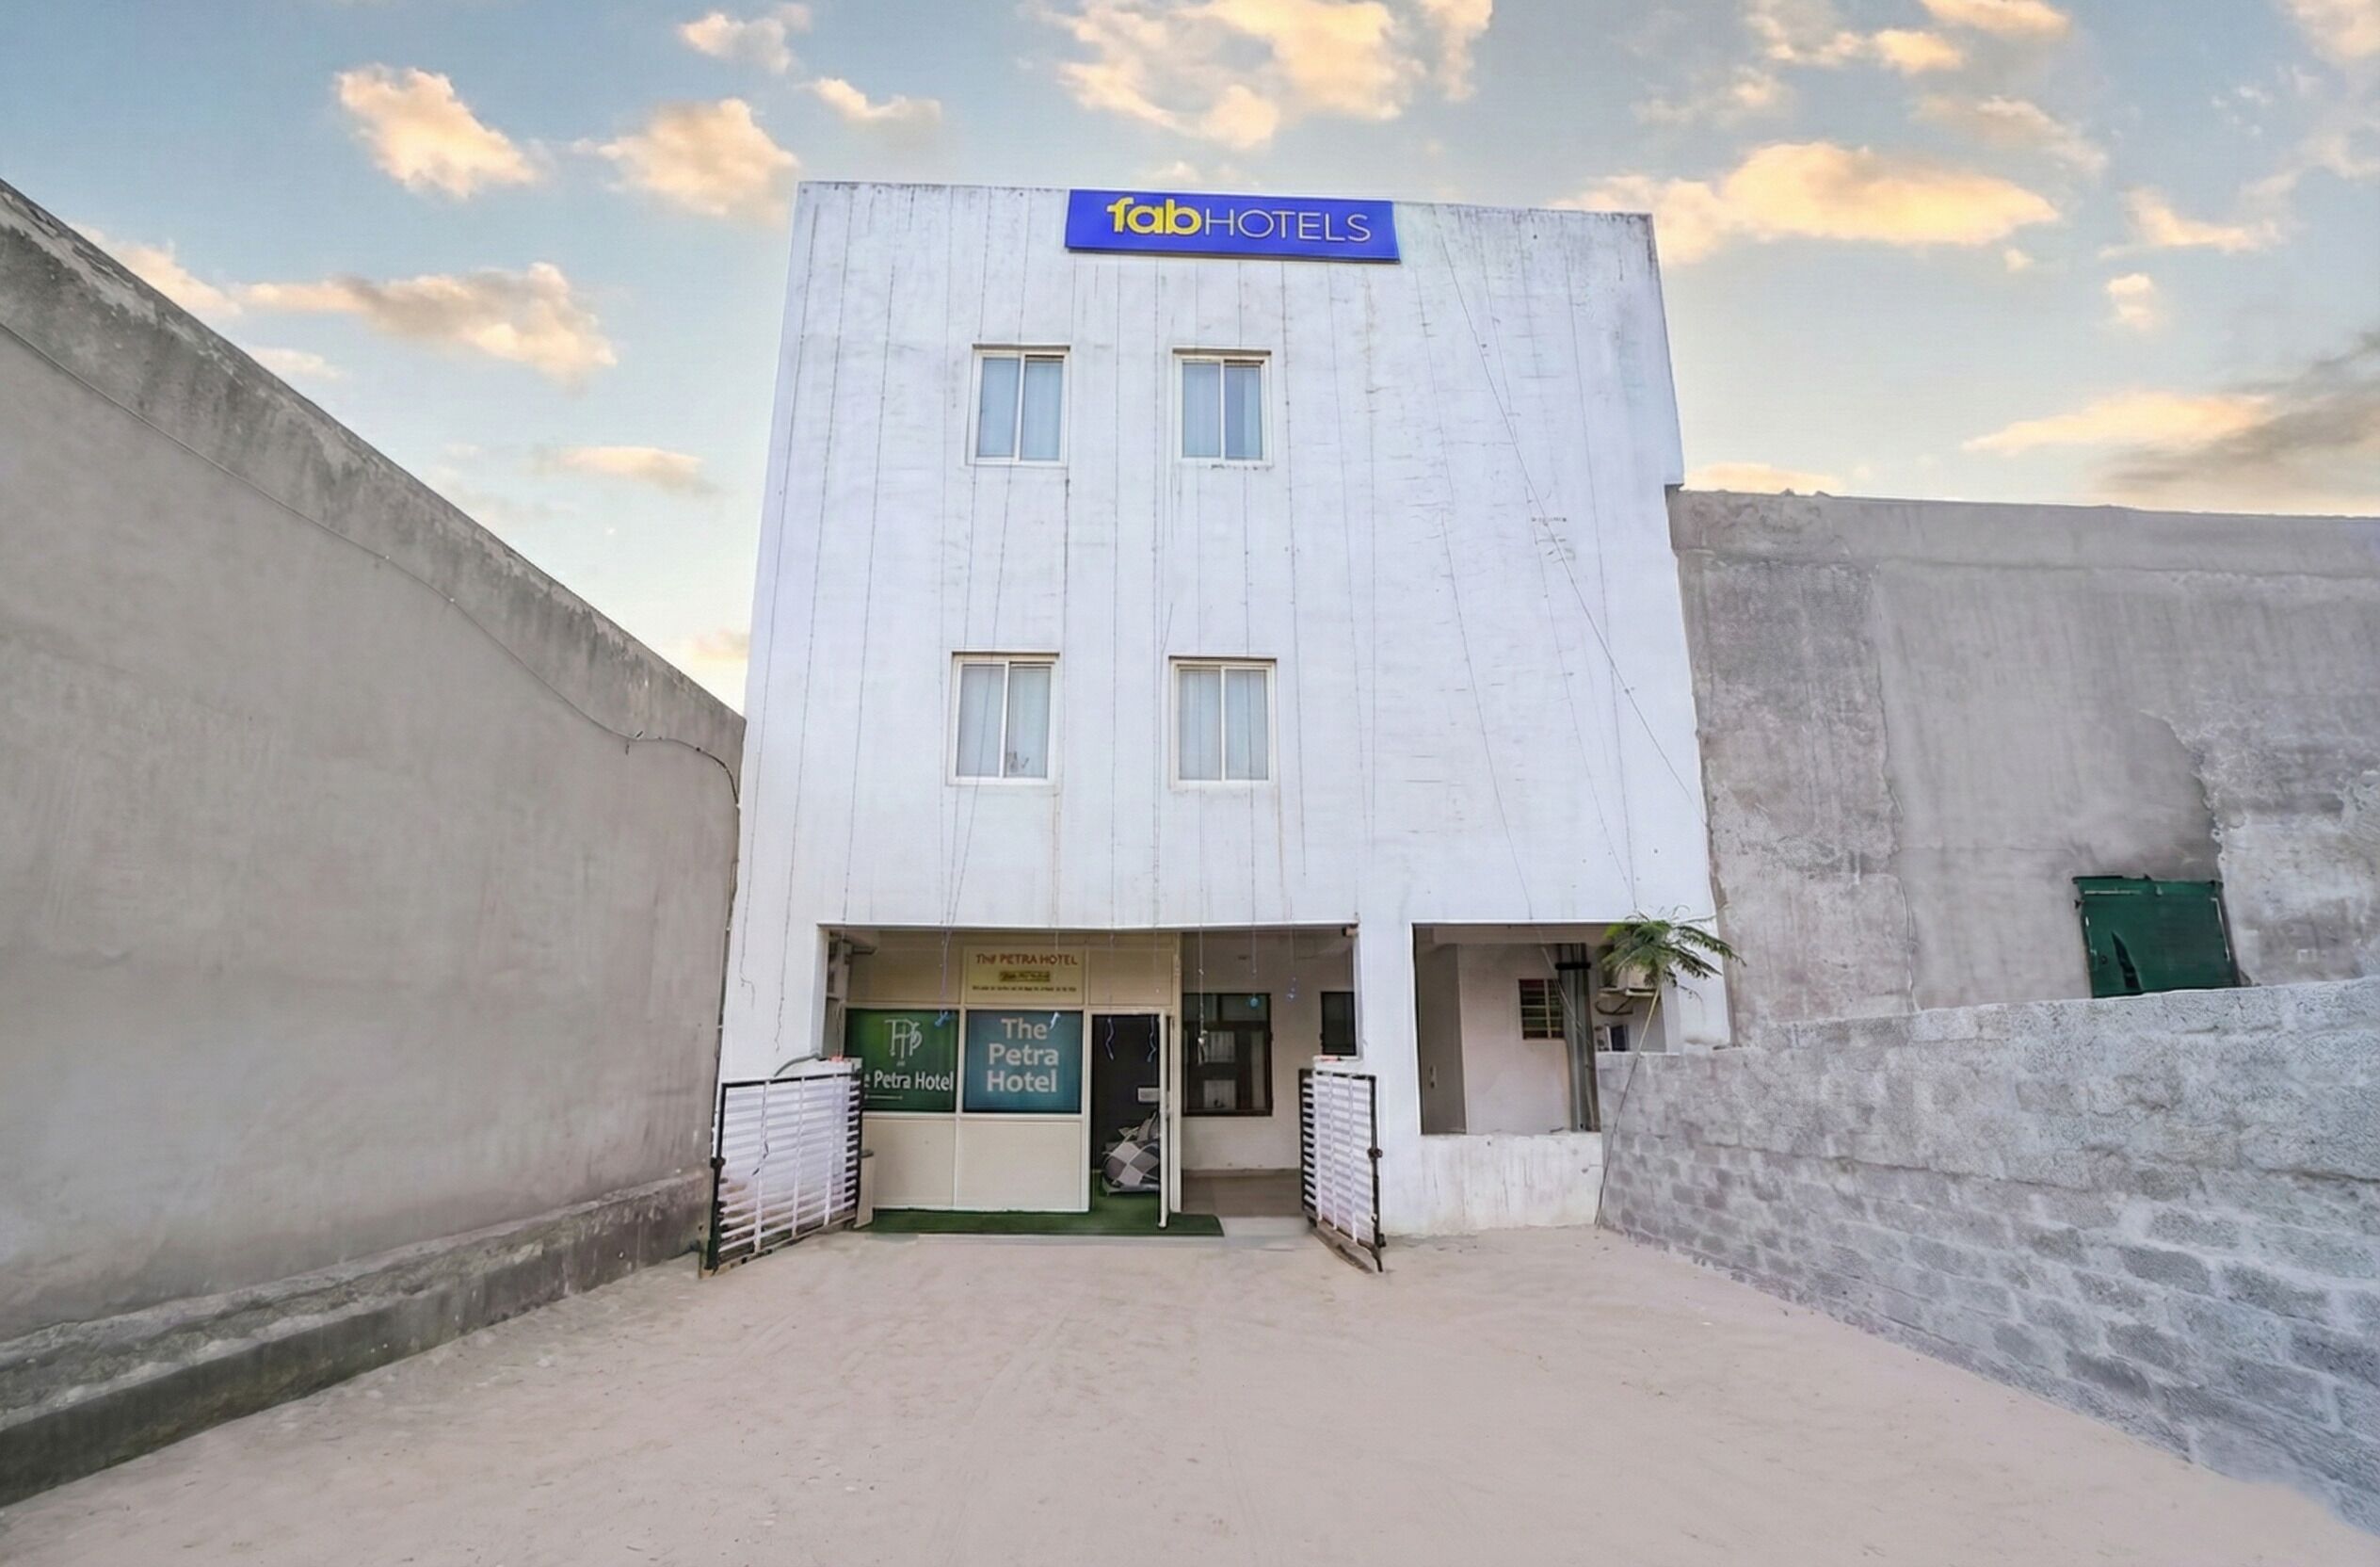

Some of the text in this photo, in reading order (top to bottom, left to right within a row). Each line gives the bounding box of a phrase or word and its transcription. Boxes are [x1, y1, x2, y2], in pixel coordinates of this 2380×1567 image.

[999, 953, 1037, 965] PETRA
[1038, 953, 1078, 966] HOTEL
[1001, 1017, 1048, 1040] The
[989, 1042, 1059, 1066] Petra
[874, 1069, 911, 1089] Petra
[915, 1071, 954, 1091] Hotel
[987, 1069, 1057, 1092] Hotel
